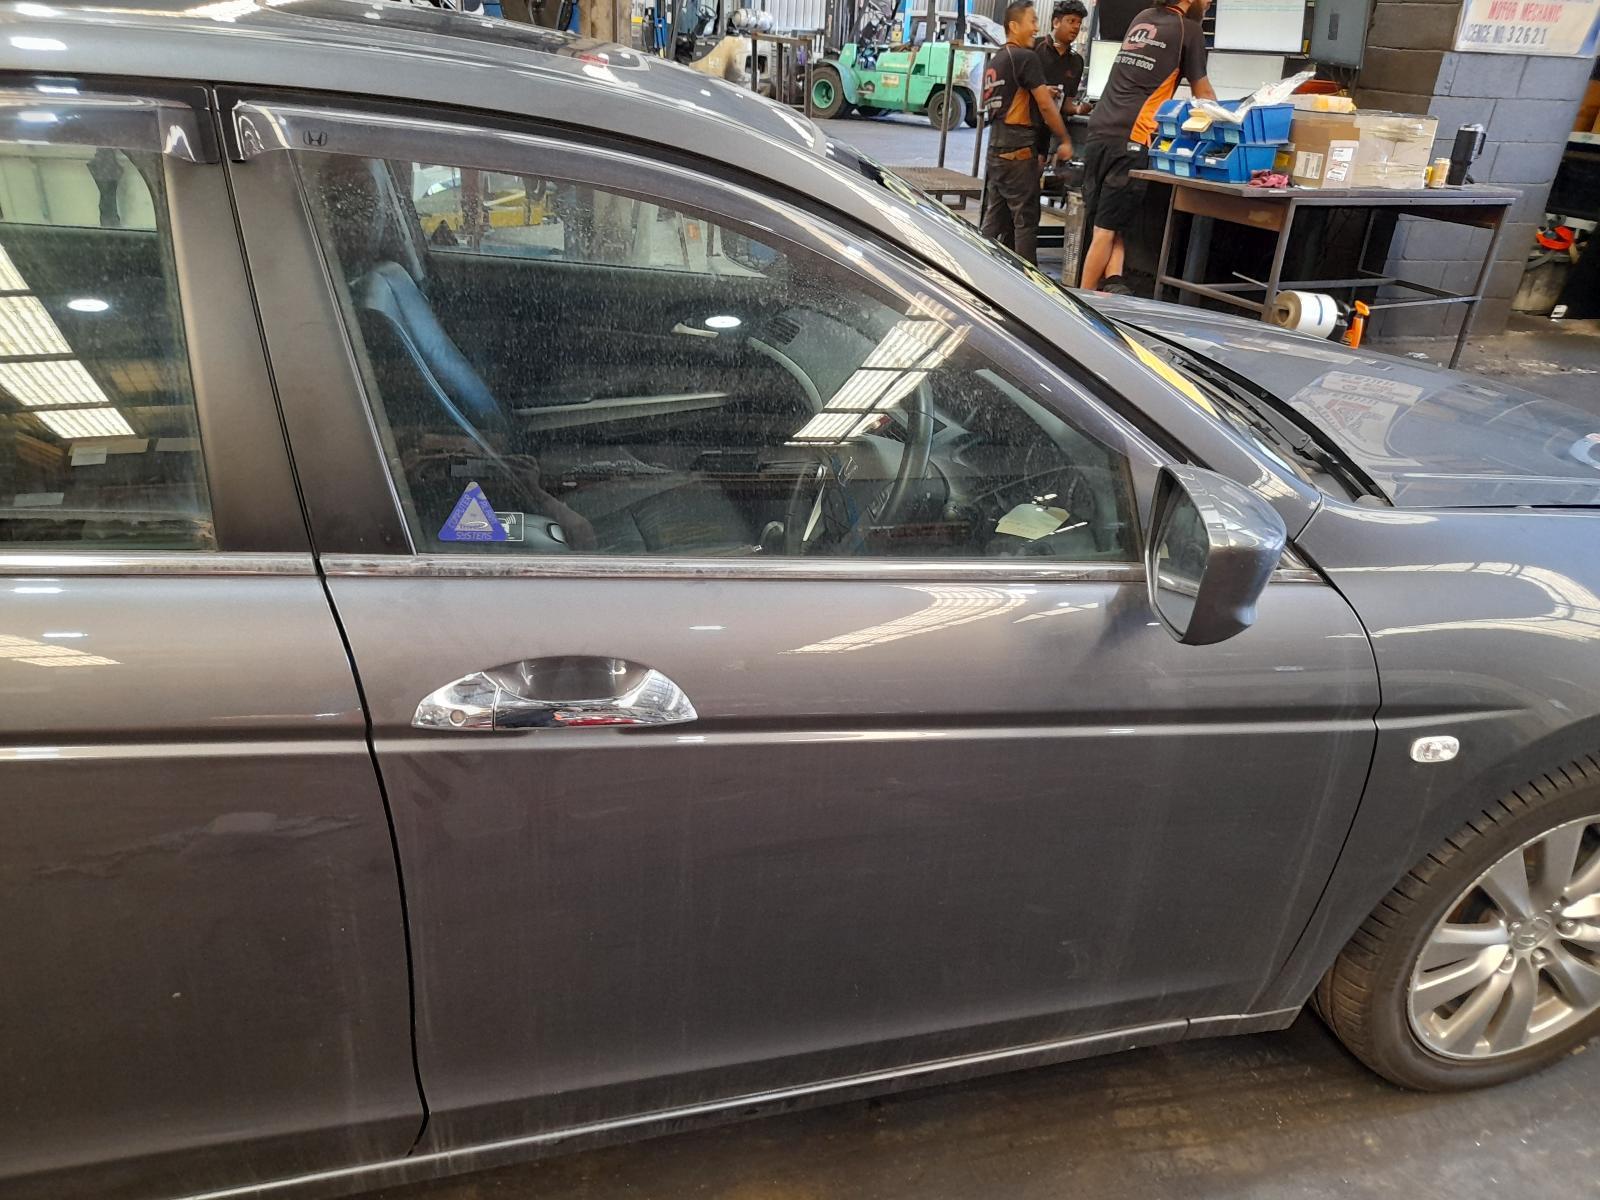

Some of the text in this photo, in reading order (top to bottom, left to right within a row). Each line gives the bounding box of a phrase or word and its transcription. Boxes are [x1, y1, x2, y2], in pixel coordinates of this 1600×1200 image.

[1488, 0, 1564, 23] MOTOR MECHANIC
[1507, 26, 1548, 45] 32621
[1121, 56, 1136, 65] 9724
[456, 532, 493, 540] SYSTEMS
